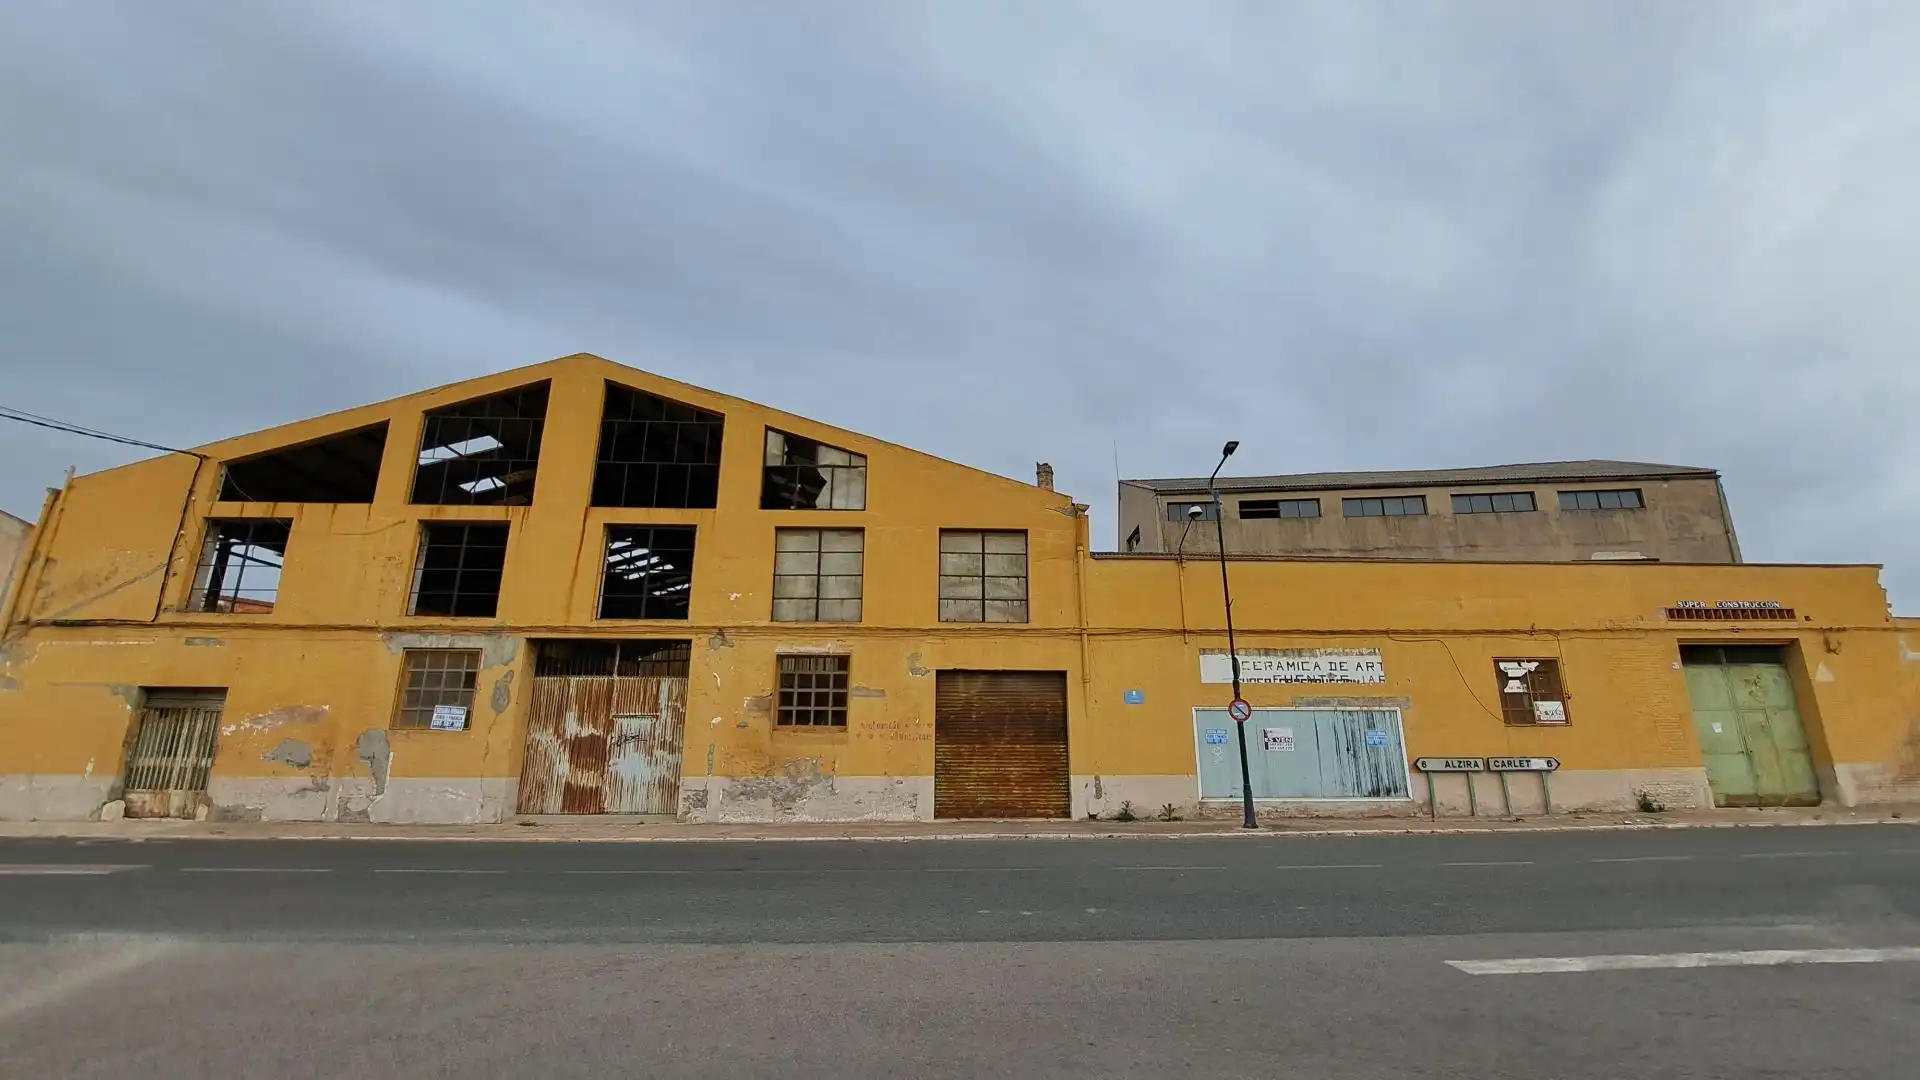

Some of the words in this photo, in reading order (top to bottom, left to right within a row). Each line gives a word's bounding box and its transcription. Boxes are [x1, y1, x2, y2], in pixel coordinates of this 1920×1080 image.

[1676, 600, 1706, 608] SUPER
[1241, 660, 1322, 671] CERAMICA
[1328, 661, 1349, 671] DE
[1421, 760, 1428, 768] 6
[1444, 760, 1480, 769] ALZIRA
[1493, 760, 1532, 768] CARLET
[1546, 759, 1553, 768] 6
